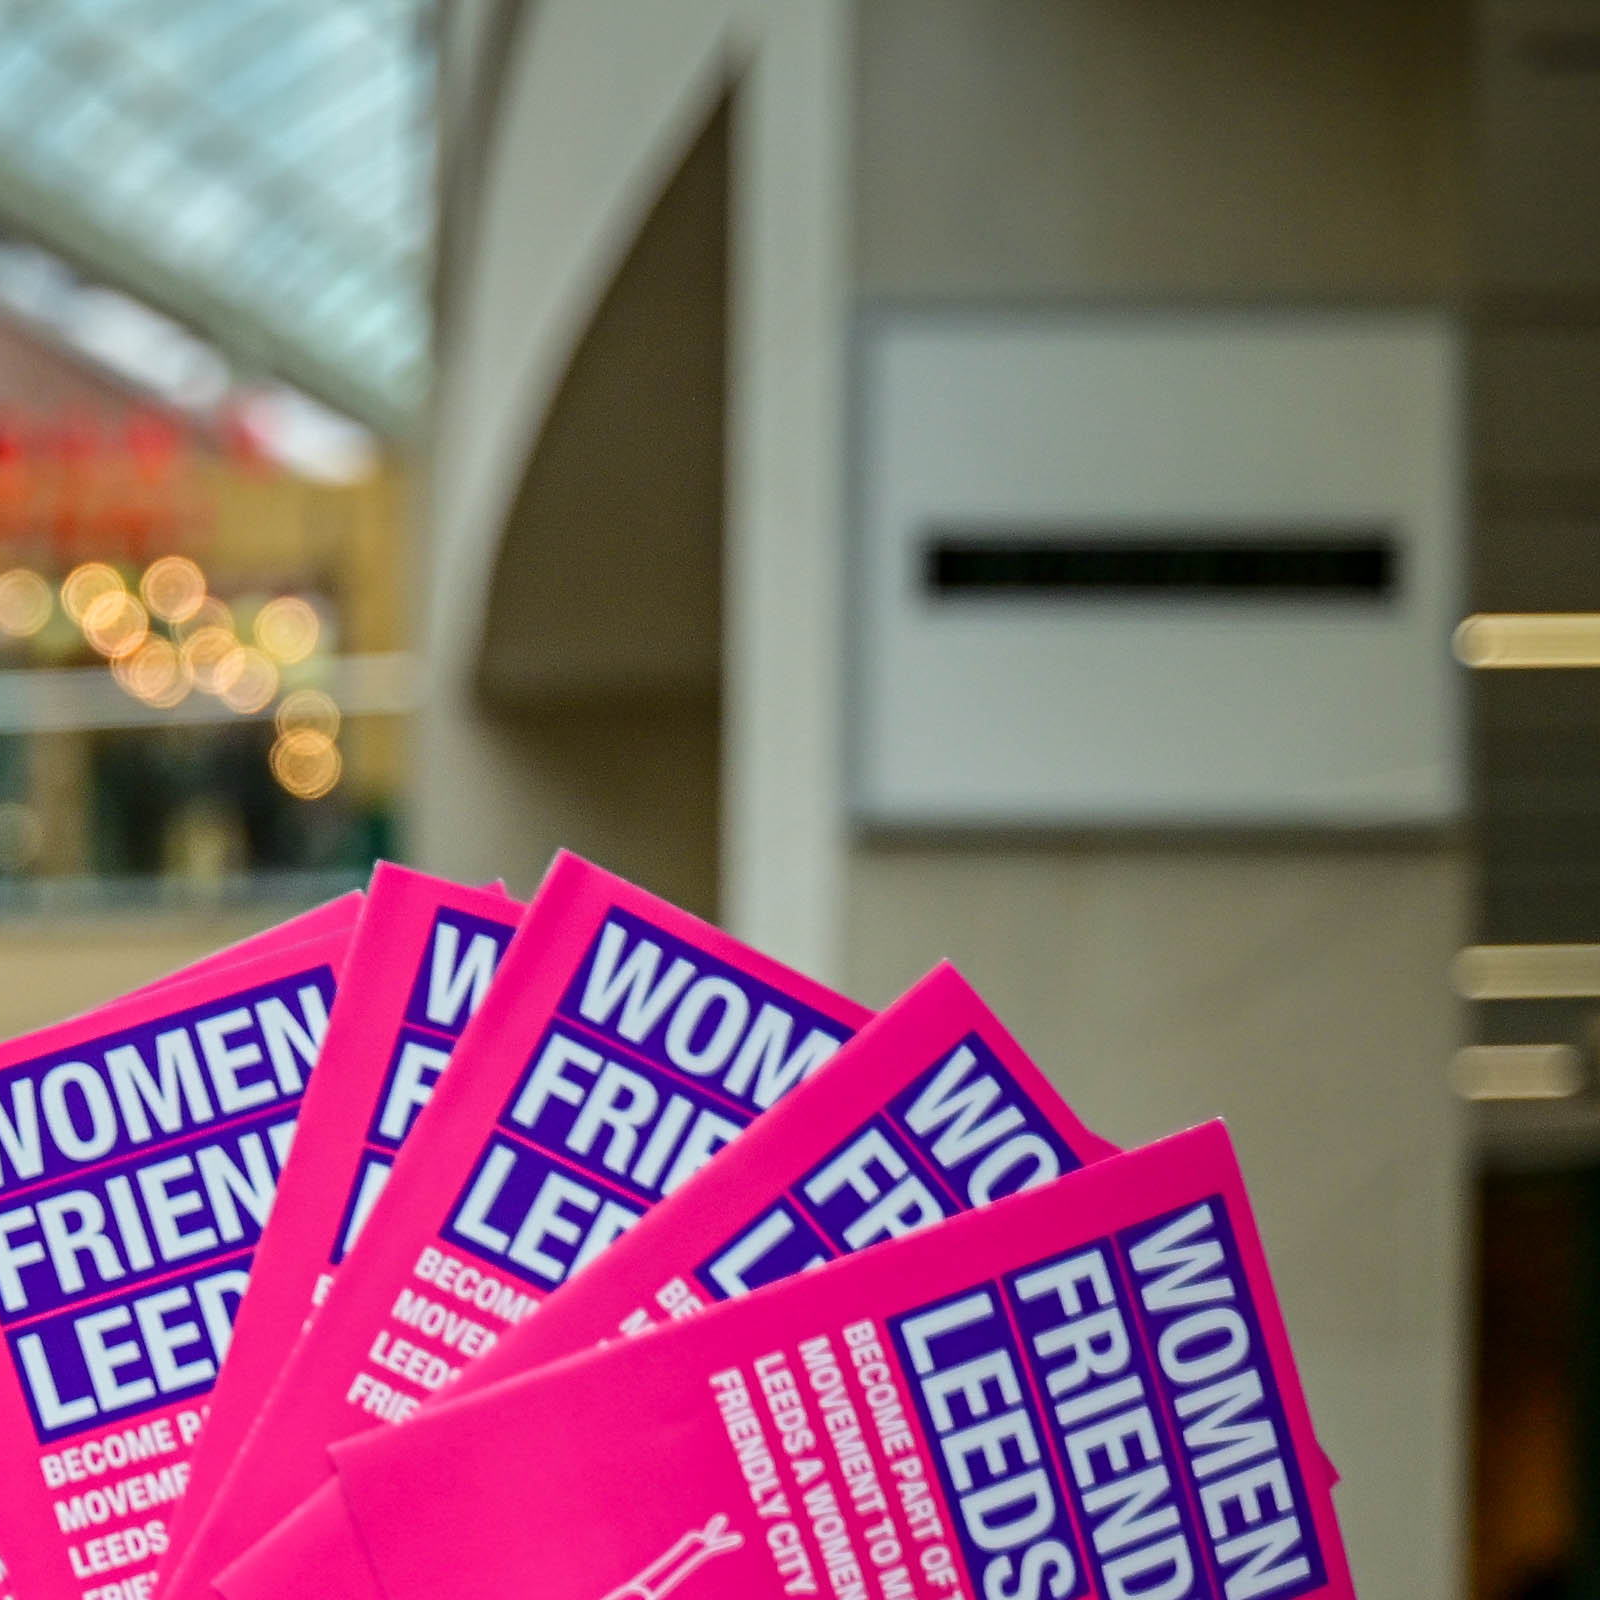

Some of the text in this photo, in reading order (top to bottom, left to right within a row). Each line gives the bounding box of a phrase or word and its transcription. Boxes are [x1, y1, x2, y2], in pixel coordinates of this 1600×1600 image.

[414, 1246, 540, 1325] BECOM
[369, 1330, 462, 1391] LEED
[40, 1418, 177, 1489] BECOME
[754, 1351, 816, 1456] LEEDS
[791, 1459, 824, 1486] A
[799, 1335, 887, 1515] MOVEMENT
[864, 1518, 902, 1565] TO
[842, 1318, 915, 1458] BECOME
[890, 1456, 944, 1541] PART
[920, 1545, 958, 1588] OF
[709, 1367, 791, 1520] FRIENDLY
[767, 1522, 818, 1596] CITY
[68, 1521, 169, 1579] LEEDS
